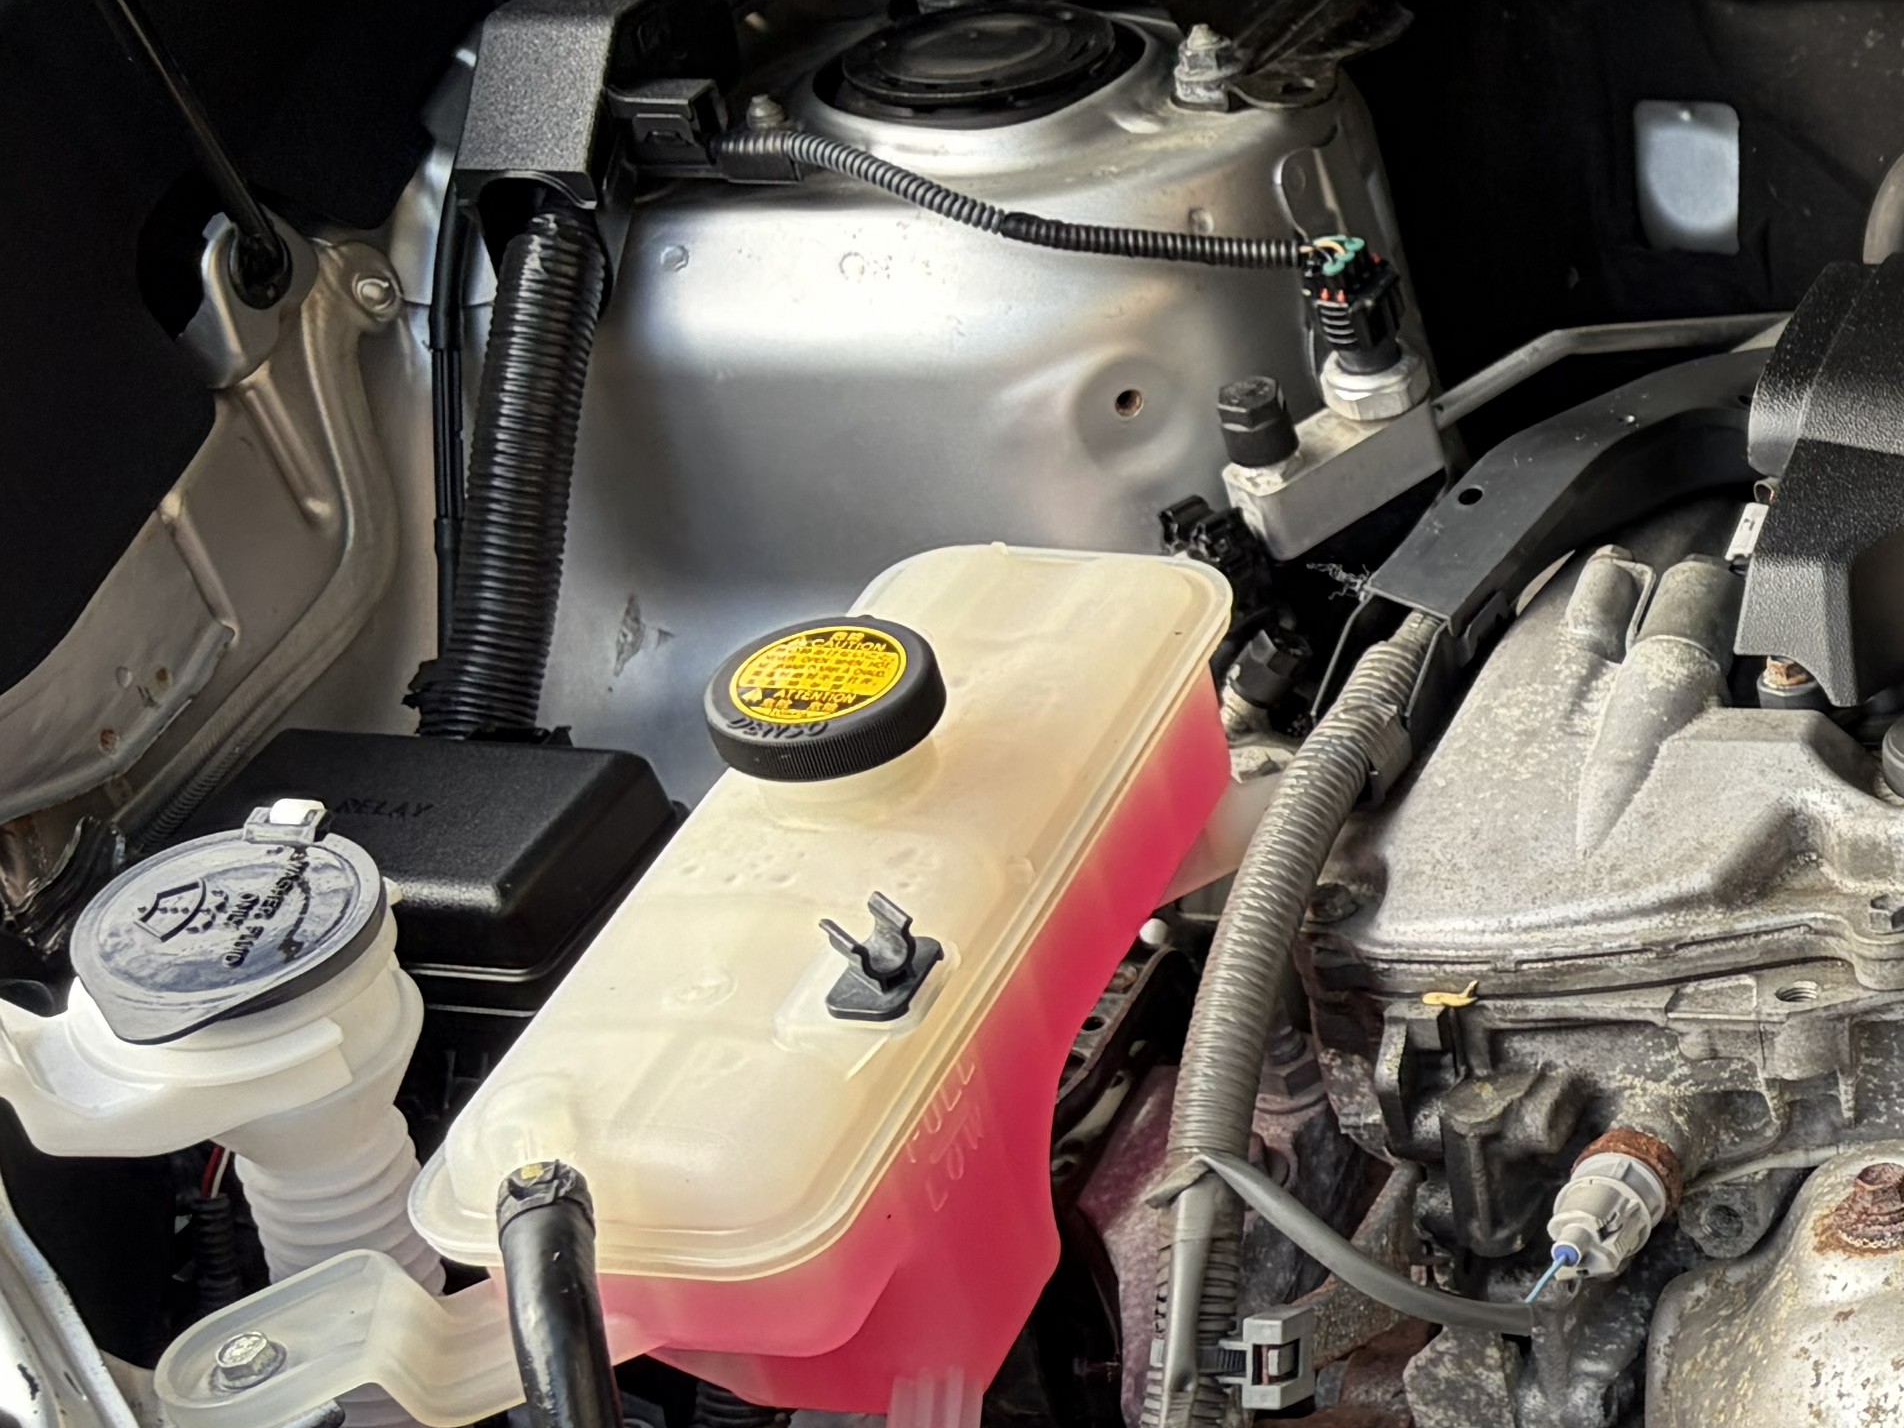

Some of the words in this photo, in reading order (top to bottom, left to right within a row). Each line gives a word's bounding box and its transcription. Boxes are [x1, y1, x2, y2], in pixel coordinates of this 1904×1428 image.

[811, 639, 887, 652] CAUTION
[773, 689, 856, 703] ATTENTION
[727, 717, 828, 739] DENSO
